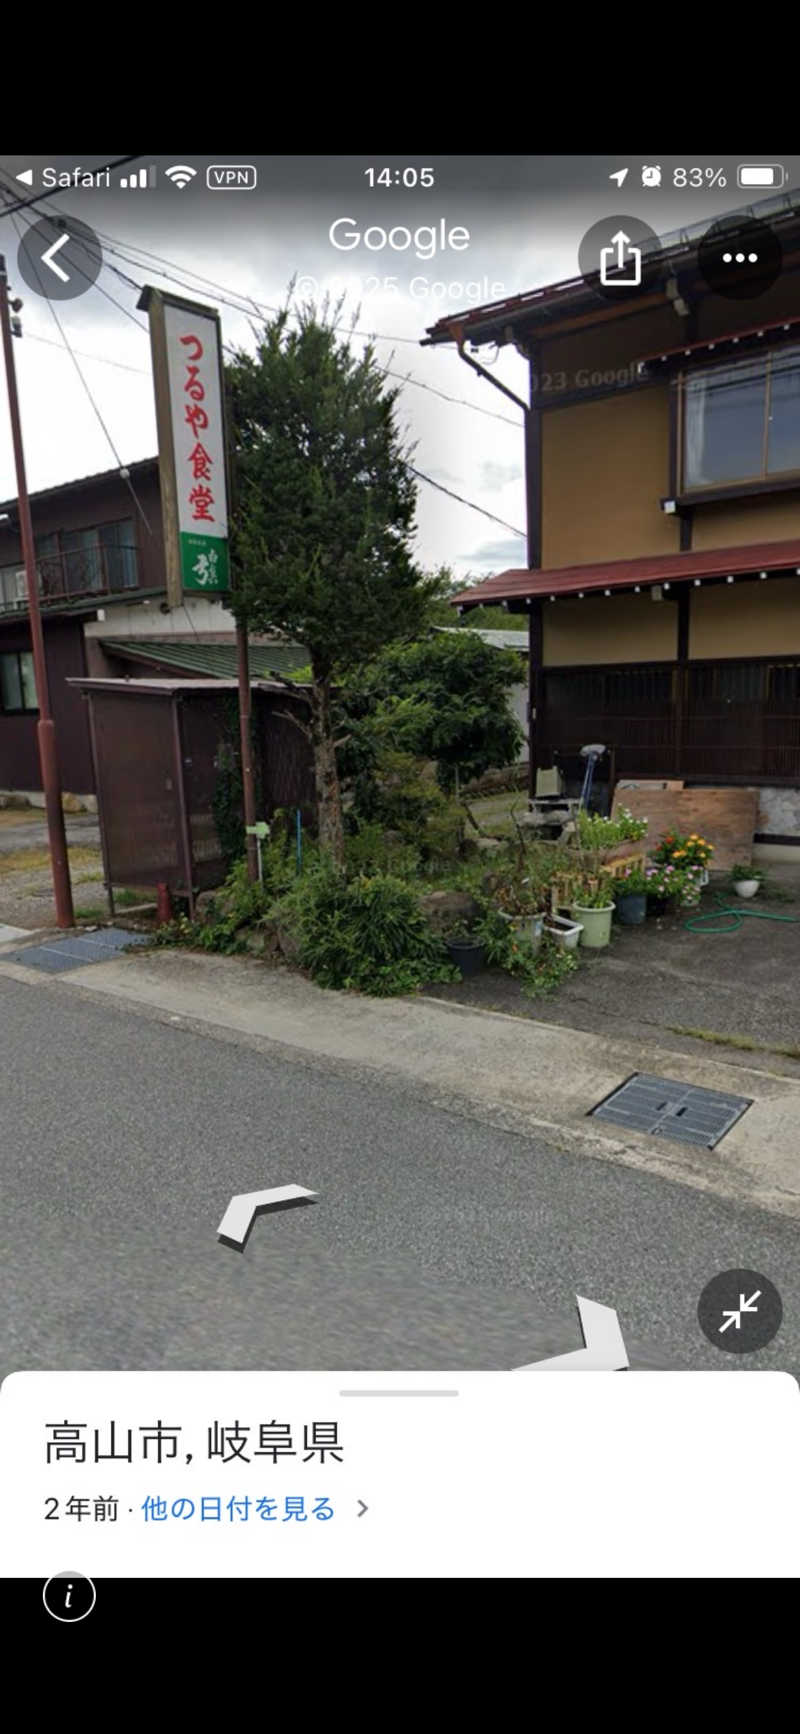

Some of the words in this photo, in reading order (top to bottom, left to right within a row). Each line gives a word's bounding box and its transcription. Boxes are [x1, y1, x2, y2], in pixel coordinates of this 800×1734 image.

[179, 334, 216, 523] つるや食堂
